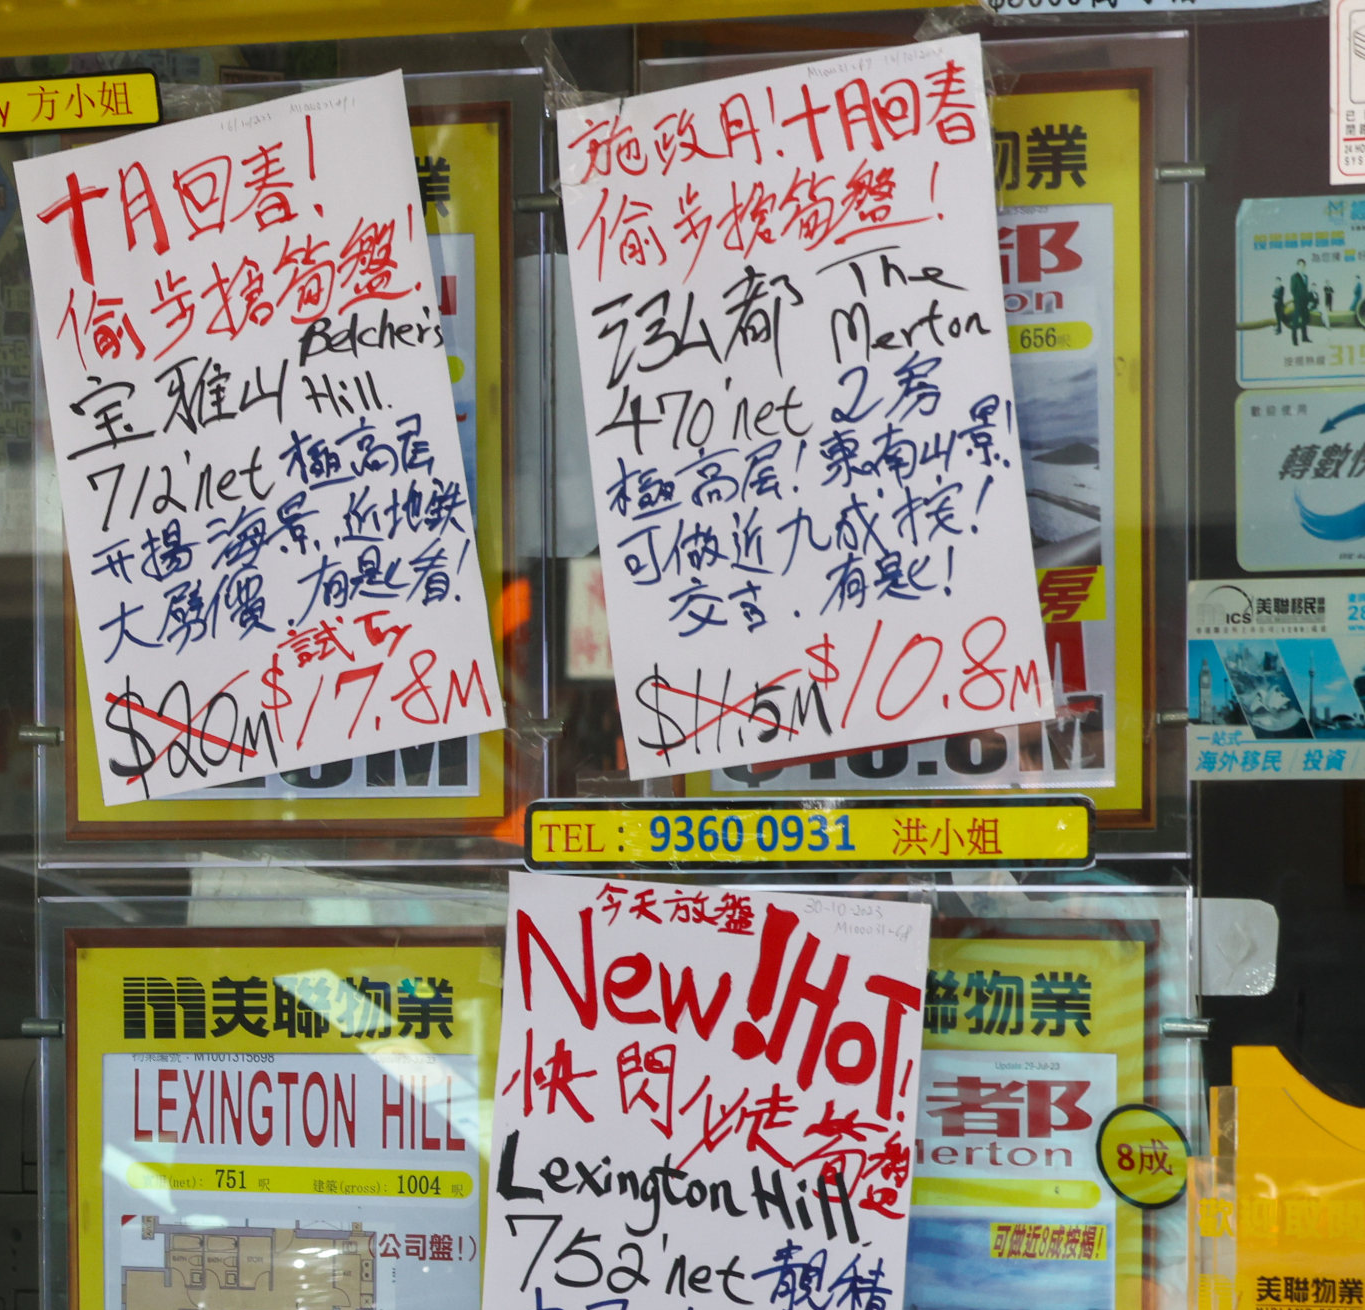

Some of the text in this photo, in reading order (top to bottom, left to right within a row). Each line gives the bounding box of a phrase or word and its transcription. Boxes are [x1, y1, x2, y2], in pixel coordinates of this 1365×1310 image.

[28, 81, 134, 125] 方小姐
[830, 299, 991, 364] Merton
[1020, 328, 1057, 348] 656
[195, 446, 275, 510] net
[1226, 613, 1252, 624] ICS
[1196, 749, 1346, 772] 海外移民 投資
[650, 814, 1003, 856] 9360 0931 洪小姐
[133, 1068, 466, 1151] LEXINGTON HILL
[1116, 1139, 1173, 1176] 8成
[215, 1169, 441, 1195] 751 1004
[496, 1128, 858, 1245] Lexington Hill
[1255, 1276, 1363, 1305] 美聯物業
